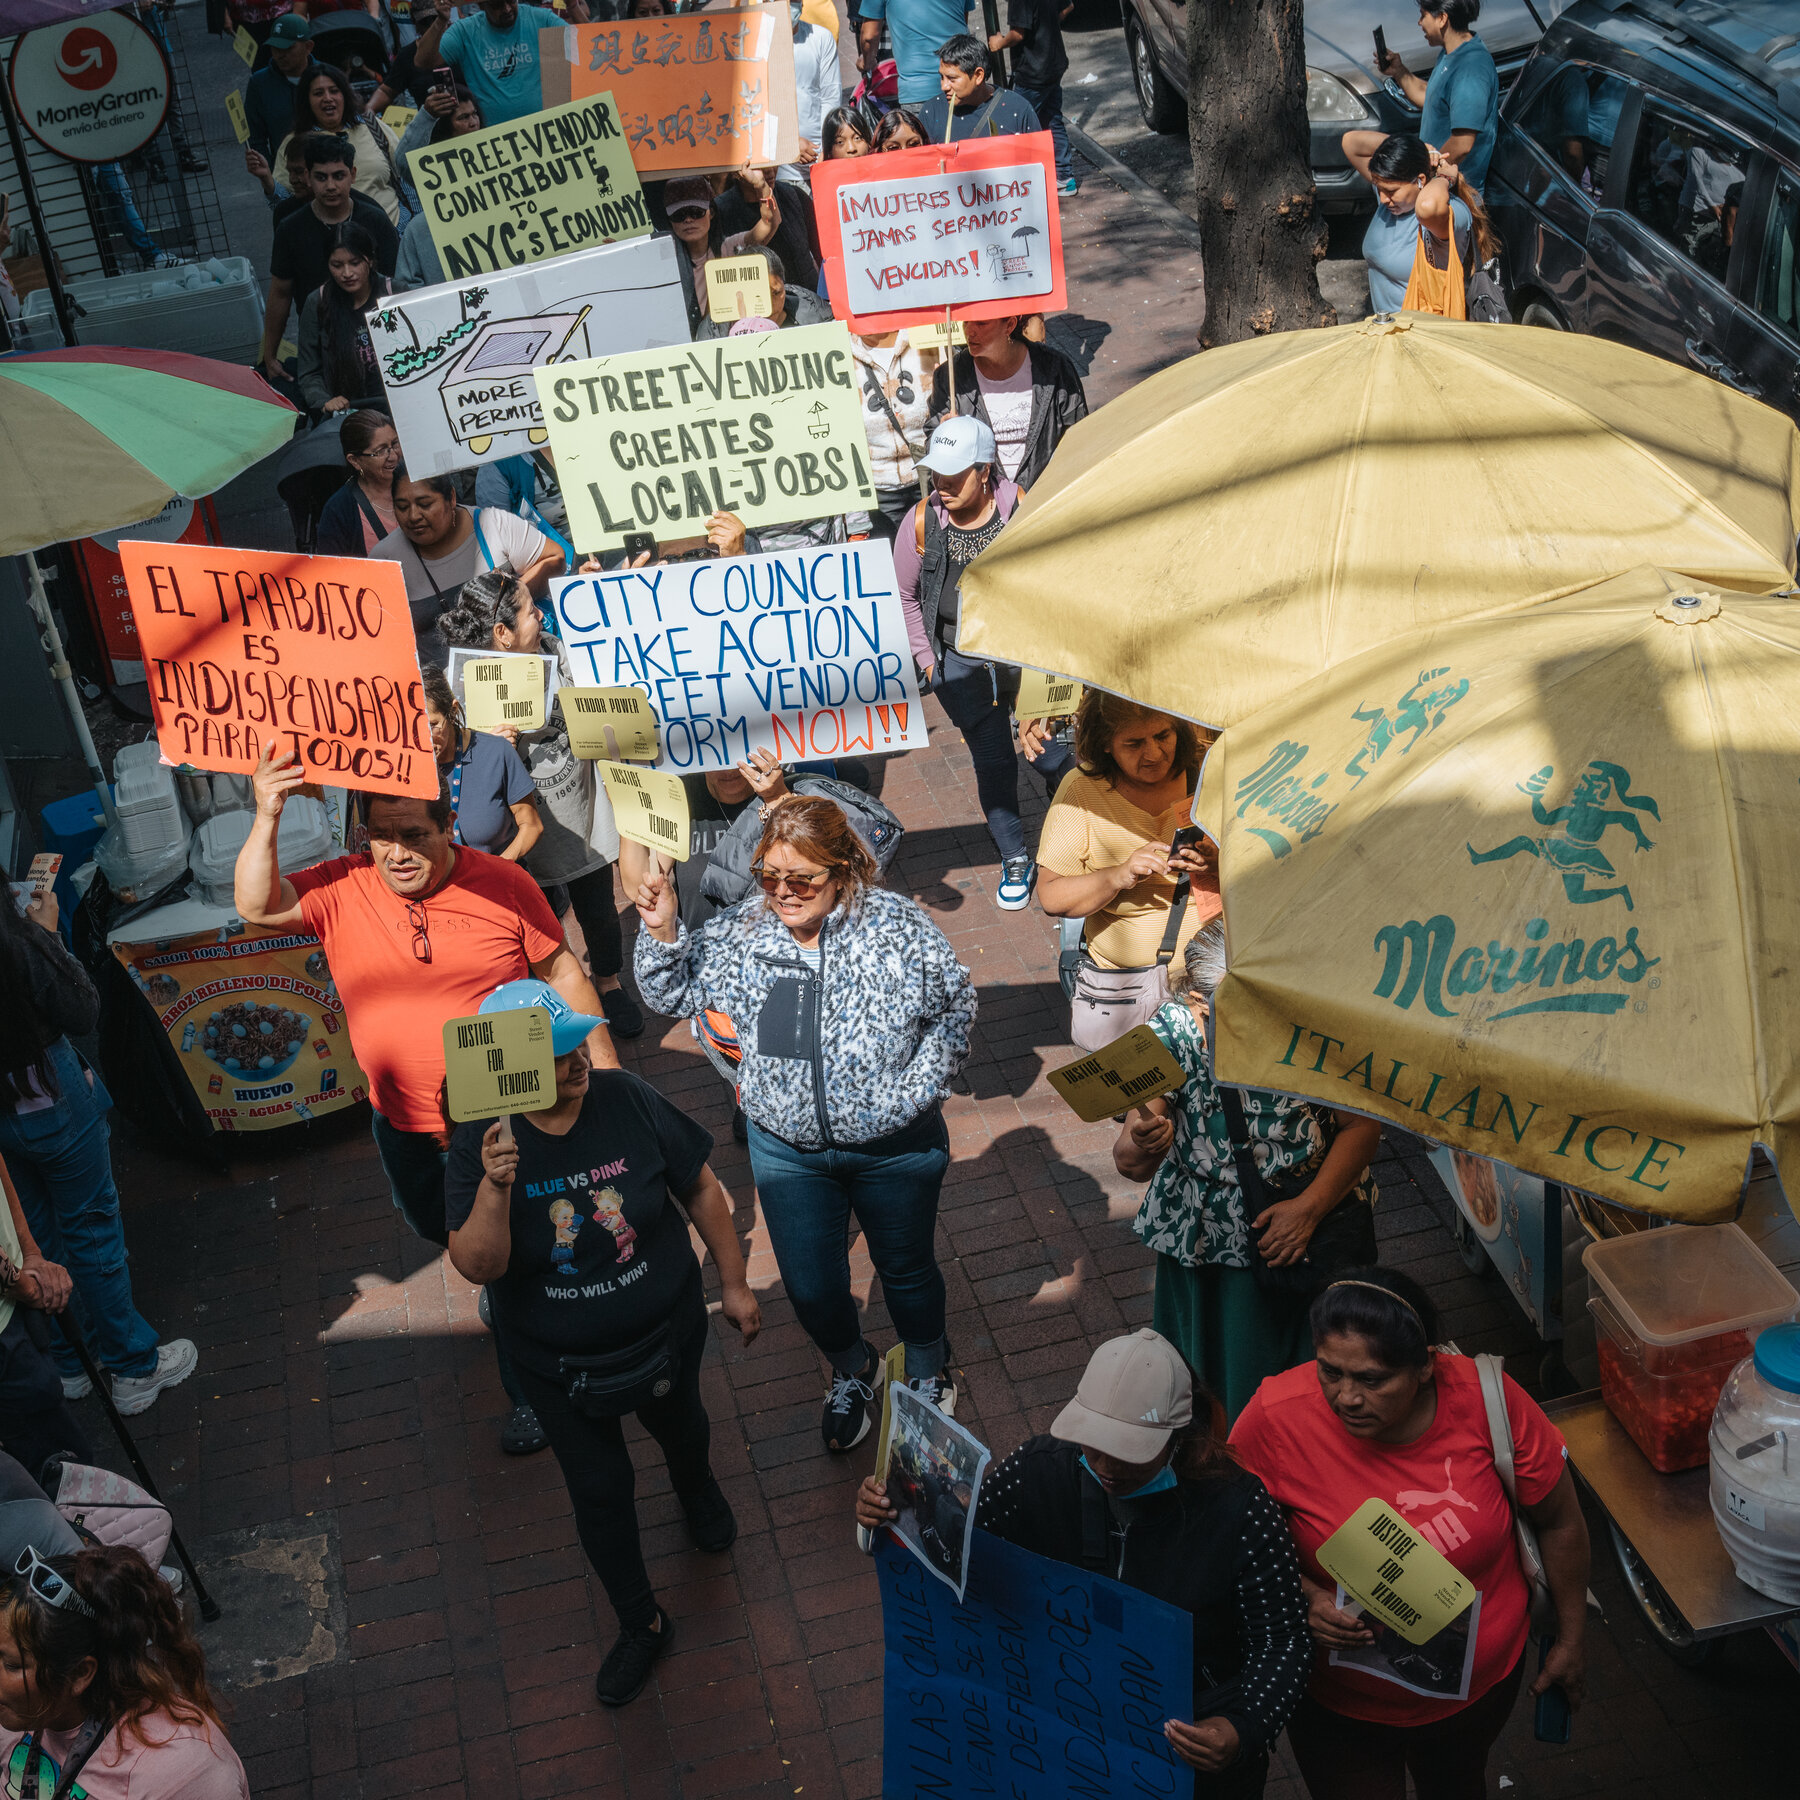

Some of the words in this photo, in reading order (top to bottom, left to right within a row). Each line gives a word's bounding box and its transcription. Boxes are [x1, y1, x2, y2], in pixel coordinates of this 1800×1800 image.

[484, 53, 533, 72] SAILING
[485, 43, 529, 60] ISLAND
[93, 115, 108, 131] de
[109, 110, 145, 126] dinero
[418, 102, 621, 191] STREET-VENDOR
[433, 146, 599, 223] CONTRIBUTE
[838, 190, 951, 223] ¡MUJERES
[957, 180, 1032, 208] UNIDAS
[509, 200, 538, 218] TO
[852, 225, 916, 253] JAMAS
[932, 207, 1023, 240] SERAMOS
[715, 268, 737, 284] VENDOR
[740, 266, 760, 281] POWER
[865, 249, 981, 290] VENCIDAS!
[457, 381, 528, 408] MORE
[553, 347, 852, 423] STREET-VENDING
[610, 413, 774, 471] CREATES
[587, 443, 872, 533] LOCAL-JOBS!
[146, 565, 196, 618] EL
[204, 569, 384, 641] TRABAJO
[559, 570, 662, 633] CITY
[689, 551, 892, 617] COUNCIL
[243, 634, 280, 665] ES
[570, 627, 698, 684] TAKE
[718, 601, 880, 673] ACTION
[476, 664, 503, 682] JUSTICE
[496, 684, 509, 701] FOR
[745, 652, 907, 712] VENDOR
[152, 658, 434, 753] INDISPENSABLE
[503, 701, 533, 719] VENDORS
[574, 698, 607, 713] VENDOR
[608, 698, 640, 714] POWER
[1047, 684, 1074, 703] VENDORS
[174, 712, 261, 761] PARA
[282, 730, 412, 785] TODOS!!
[772, 702, 909, 761] NOW!!
[555, 760, 575, 782] POWER
[556, 780, 577, 800] 1966
[610, 767, 643, 788] JUSTICE
[638, 791, 653, 810] FOR
[1234, 740, 1340, 844] Marinos
[649, 812, 679, 843] VENDORS
[397, 918, 471, 932] GESS
[145, 951, 189, 968] SABOR
[193, 946, 229, 960] 100%
[231, 934, 320, 956] ECUATORIANO
[1373, 914, 1661, 1017] Marinos
[162, 993, 197, 1032] RROZ
[195, 974, 266, 1002] RELLENO
[268, 974, 293, 991] DE
[292, 980, 344, 1013] POLLO
[457, 1021, 496, 1049] JUSTICE
[487, 1048, 504, 1073] FOR
[1062, 1058, 1105, 1085] JUSTICE
[1100, 1069, 1122, 1088] FOR
[233, 1082, 295, 1102] HUEVO
[497, 1069, 541, 1097] VENDORS
[1119, 1066, 1166, 1098] VENDORS
[249, 1101, 293, 1118] AGUAS
[303, 1086, 346, 1106] JUGOS
[1275, 1022, 1544, 1145] ITALIAN
[1549, 1113, 1687, 1192] ICE
[525, 1178, 566, 1199] BLUE
[567, 1172, 589, 1190] VS
[590, 1158, 629, 1183] PINK
[545, 1286, 579, 1300] WHO
[581, 1281, 616, 1299] WILL
[617, 1261, 648, 1288] WIN?
[1367, 1513, 1418, 1561] JUSTICE
[1415, 1507, 1472, 1556] MA
[1376, 1558, 1404, 1585] FOR
[889, 1560, 940, 1678] CALLES
[1371, 1581, 1422, 1627] VENDORS
[950, 1639, 985, 1678] SE
[1041, 1575, 1112, 1800] NDEDORES
[908, 1691, 952, 1764] LAS
[960, 1688, 997, 1793] VENDE
